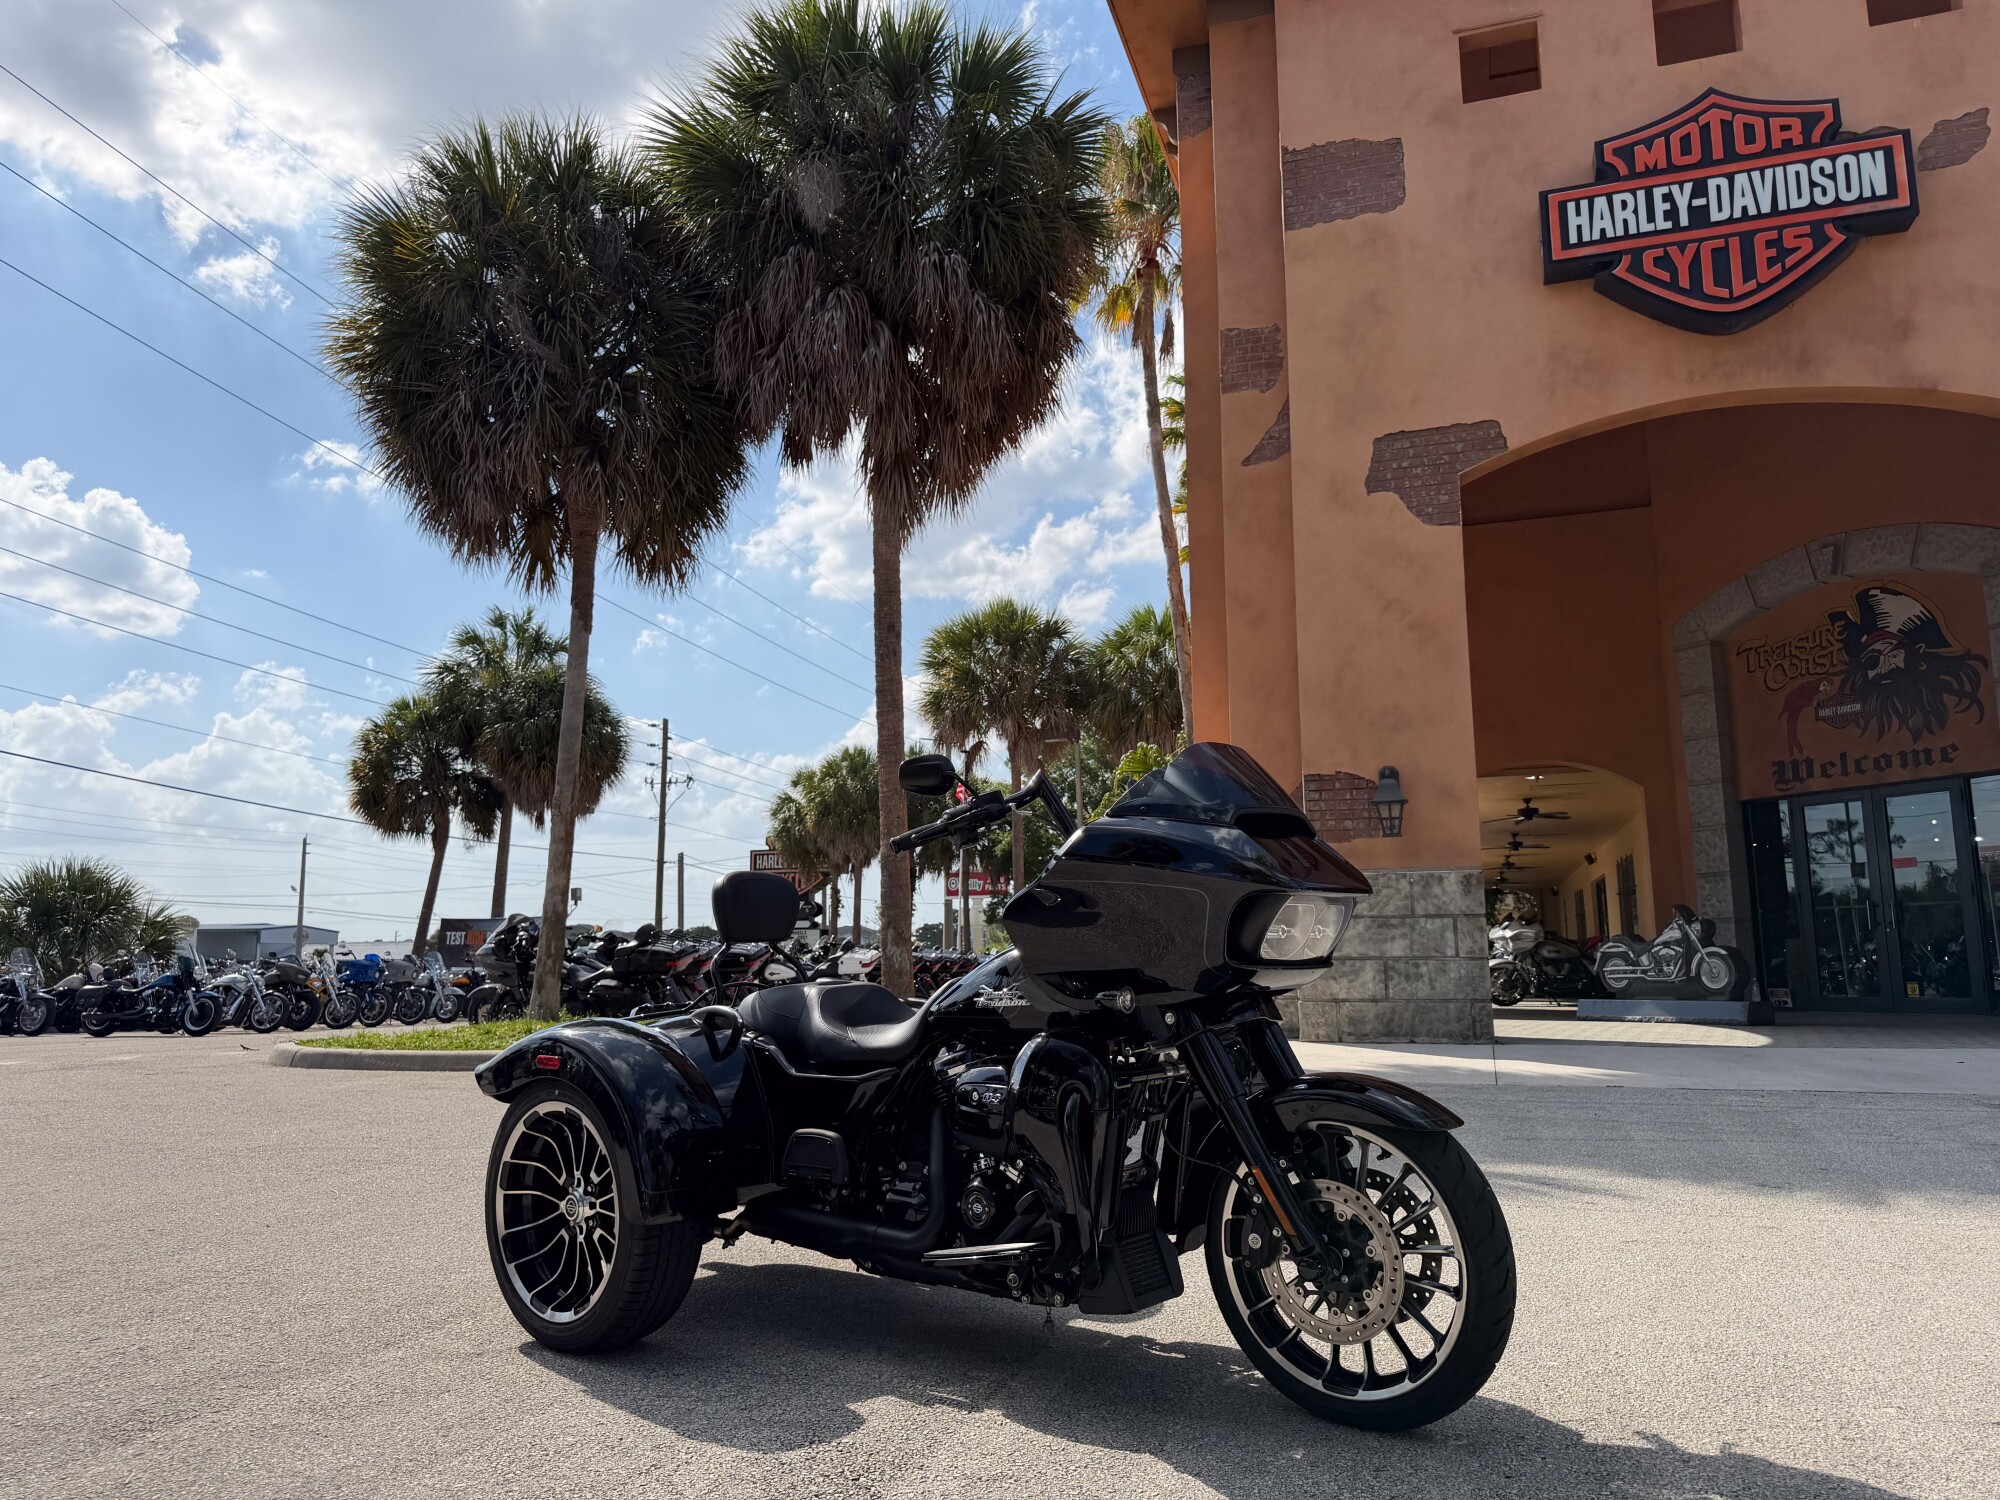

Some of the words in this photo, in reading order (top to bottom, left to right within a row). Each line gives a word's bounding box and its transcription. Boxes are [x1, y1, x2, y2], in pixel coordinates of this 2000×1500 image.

[1634, 108, 1803, 173] MOTOR
[1567, 150, 1888, 244] HARLEY-DAVIDSON
[1642, 224, 1814, 299] CYCLES
[1737, 620, 1848, 673] TREASURE
[1764, 644, 1844, 692] COAST
[1772, 742, 1960, 792] Welcome
[446, 931, 466, 945] TEST
[467, 931, 486, 945] RIDE
